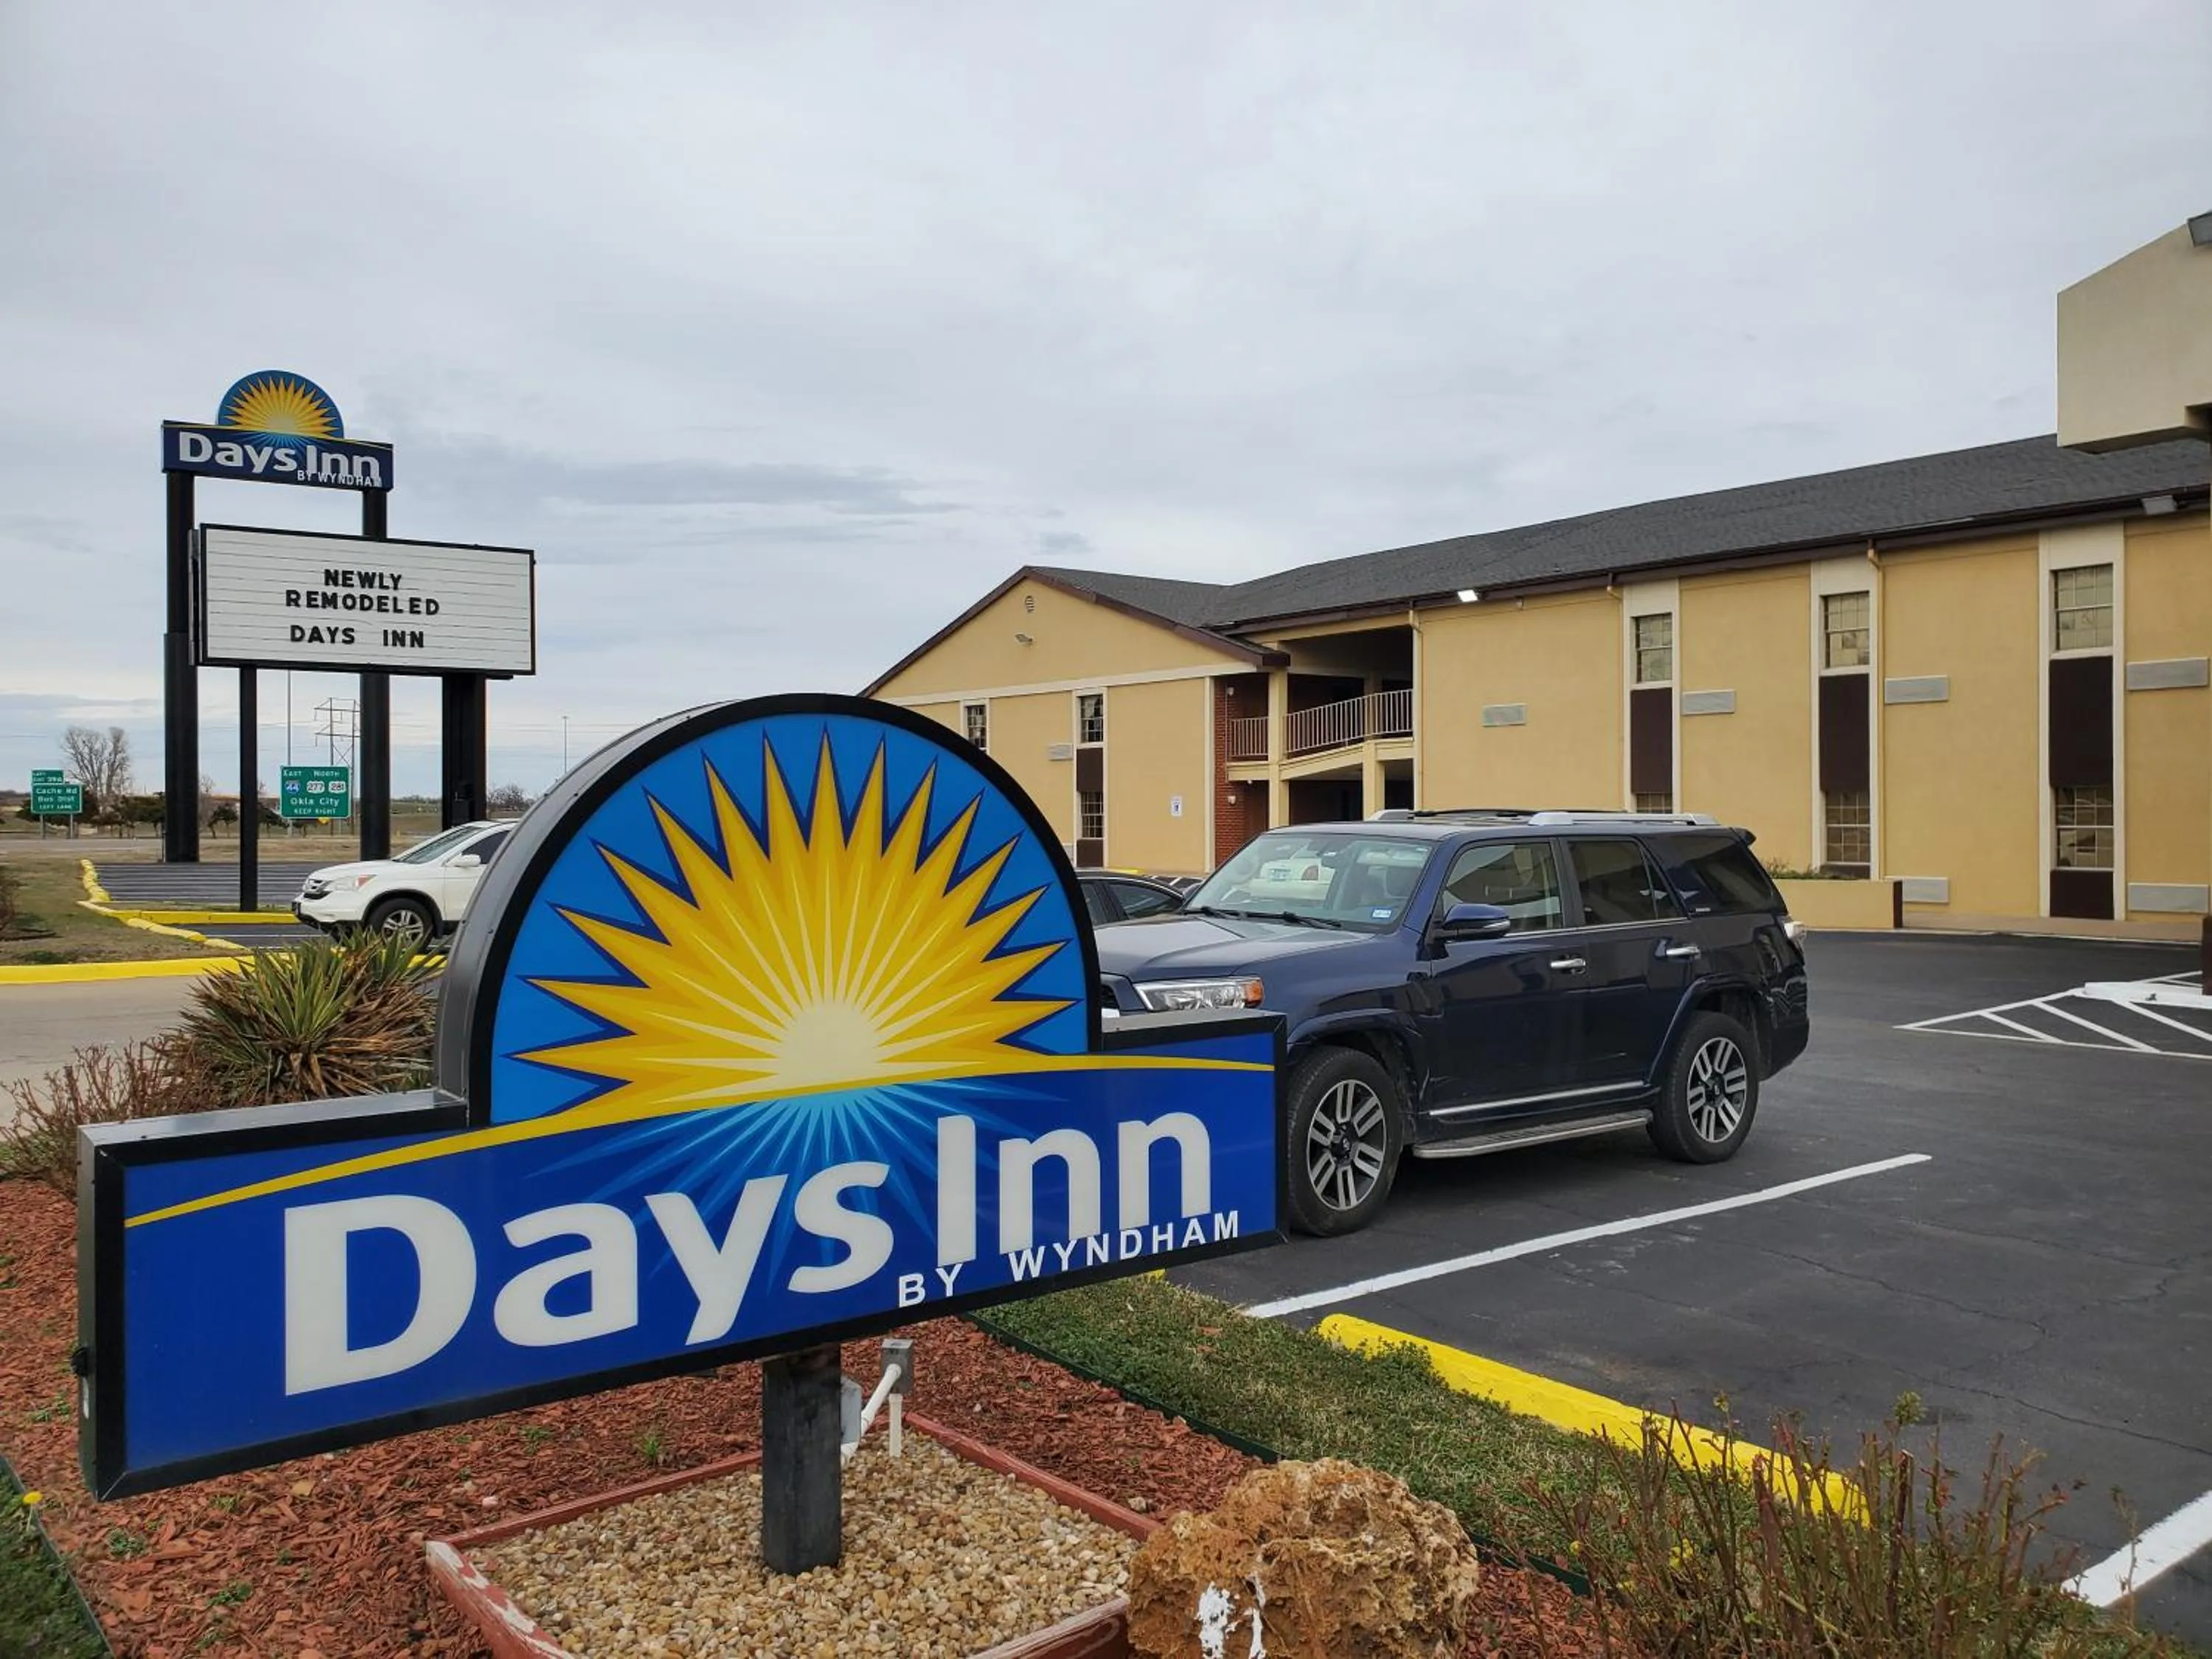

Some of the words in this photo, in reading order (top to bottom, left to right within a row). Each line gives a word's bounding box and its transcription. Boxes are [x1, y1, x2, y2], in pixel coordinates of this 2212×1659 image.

[178, 431, 297, 473] Days
[306, 445, 380, 479] Inn
[296, 470, 313, 481] BY
[318, 471, 383, 488] WYNDHAM
[324, 569, 402, 590] NEWLY
[285, 589, 440, 616] REMODELED
[290, 625, 355, 644] DAYS
[383, 629, 425, 648] INN
[307, 782, 323, 791] 277
[290, 797, 315, 806] Okla
[319, 797, 339, 807] City
[285, 1161, 894, 1396] Days
[936, 1110, 1211, 1268] Inn
[899, 1263, 963, 1308] BY
[1008, 1210, 1239, 1282] WYNDHAM
